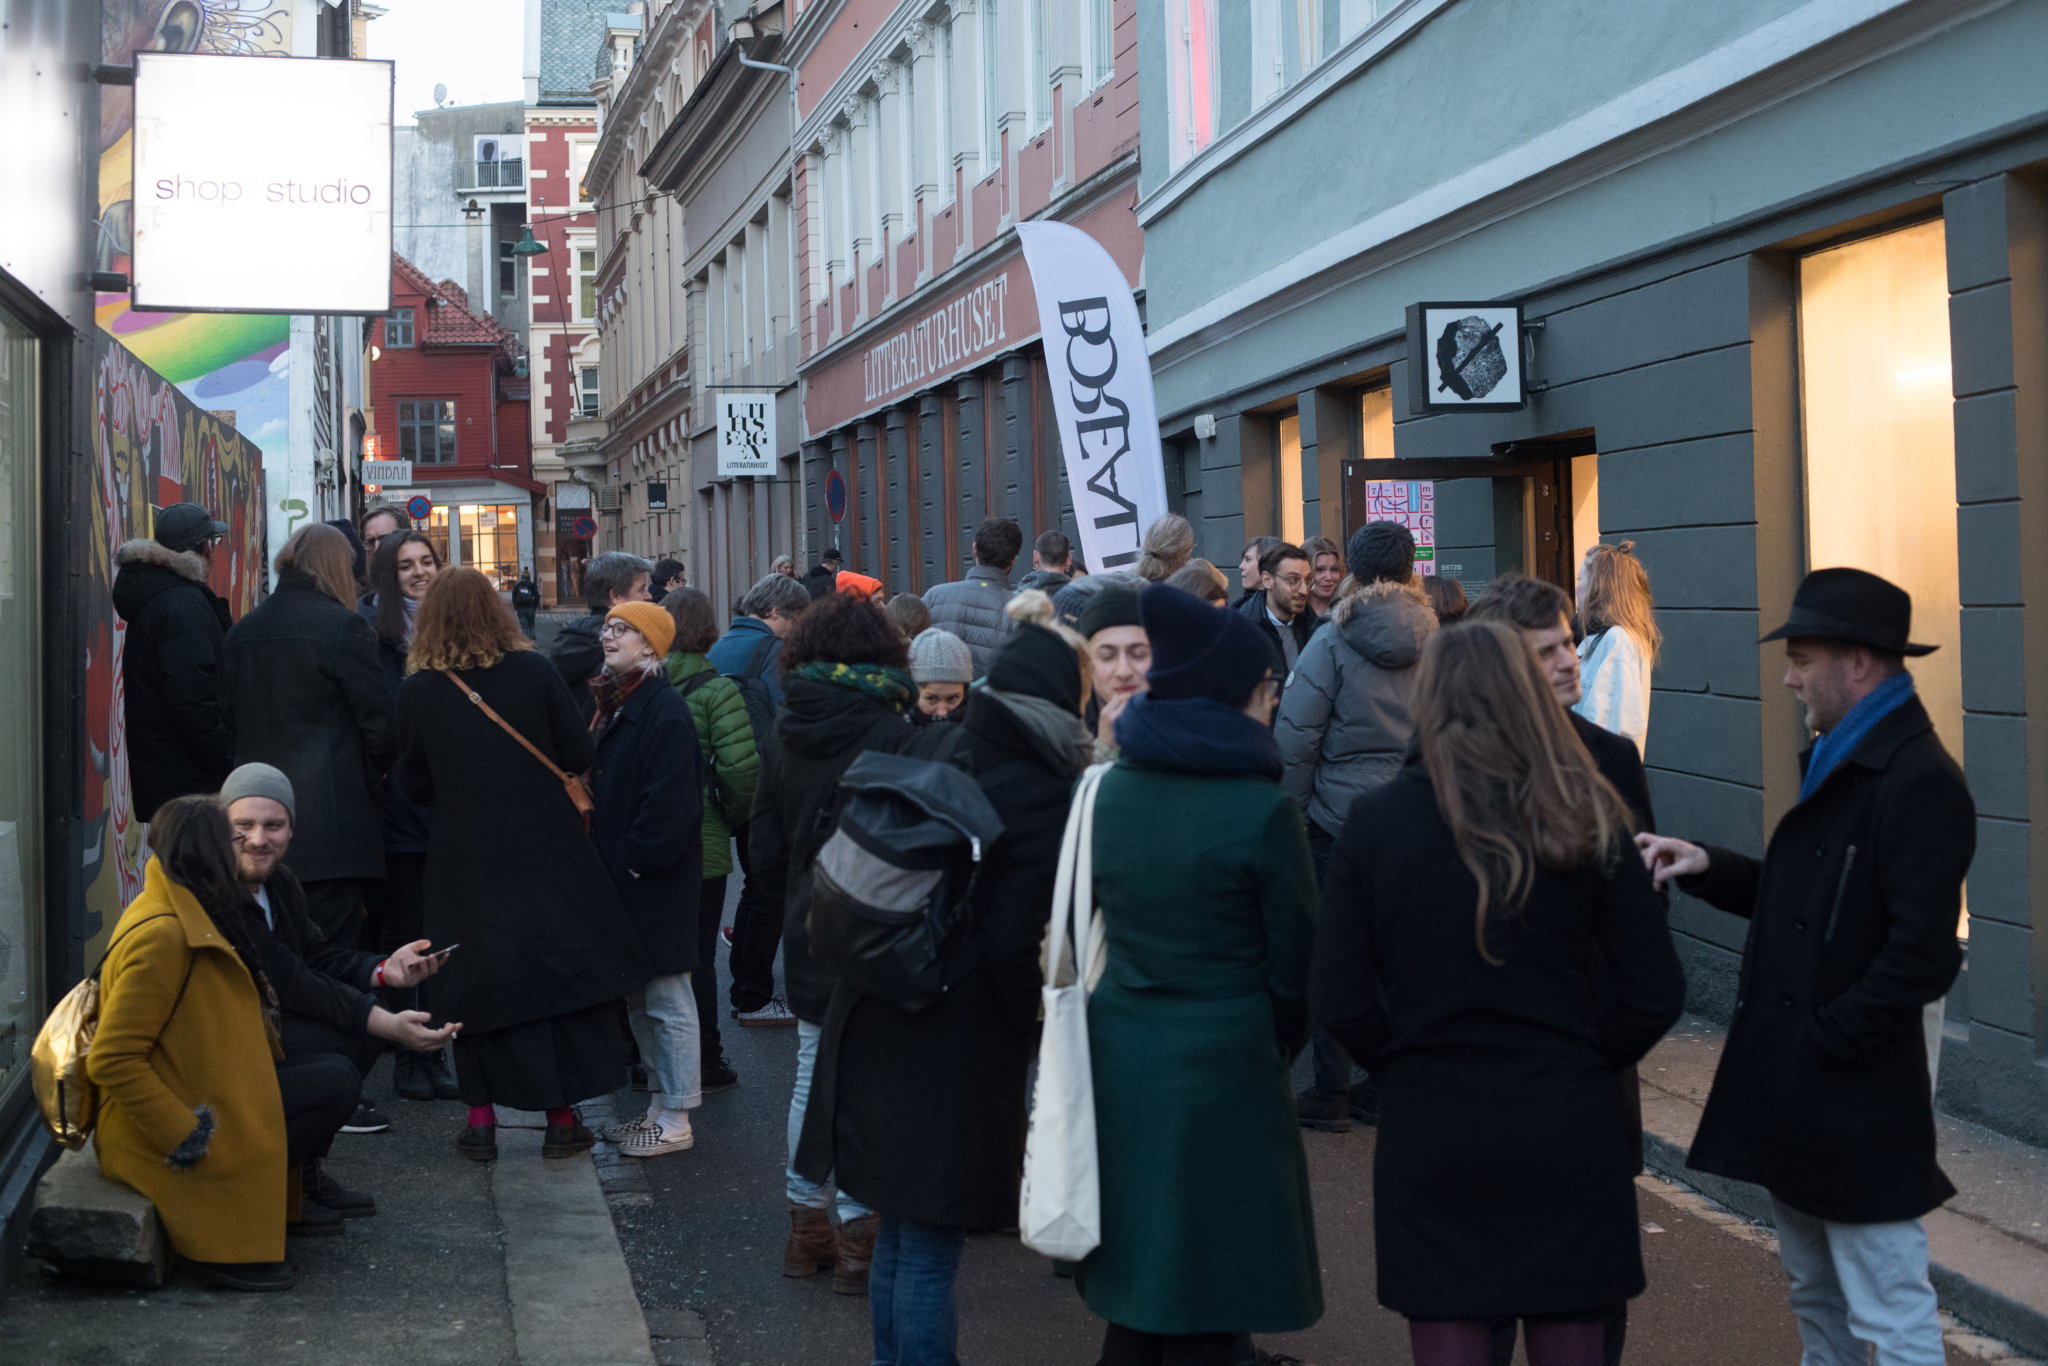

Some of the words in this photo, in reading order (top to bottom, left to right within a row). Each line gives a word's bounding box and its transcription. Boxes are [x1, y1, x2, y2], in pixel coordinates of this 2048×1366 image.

[155, 174, 243, 206] shop
[266, 178, 372, 205] studio
[863, 272, 1008, 402] LITTERATURHUSET
[366, 465, 408, 480] VINBAR
[726, 461, 768, 469] LITTERATURHUSET
